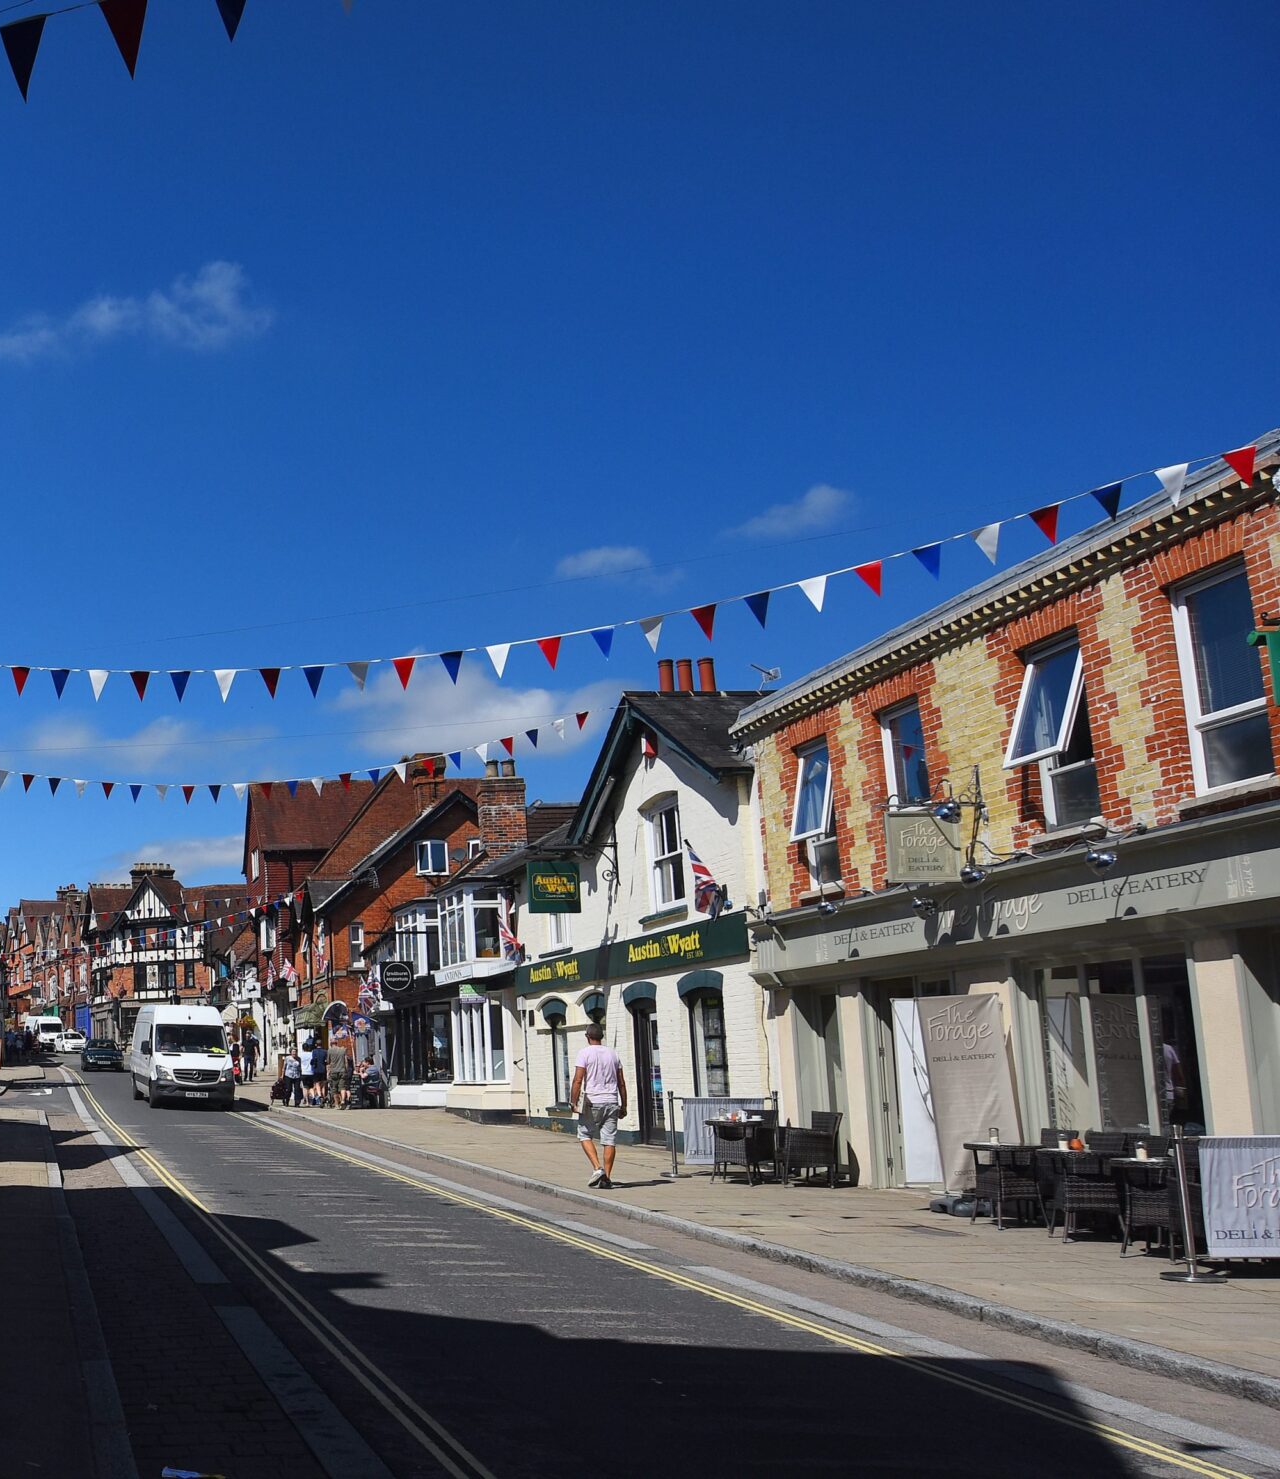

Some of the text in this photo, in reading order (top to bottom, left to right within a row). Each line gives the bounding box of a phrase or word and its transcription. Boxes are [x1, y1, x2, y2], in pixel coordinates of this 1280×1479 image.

[900, 826, 948, 853] Forage
[907, 819, 937, 836] The
[535, 874, 568, 886] Austin
[1111, 883, 1123, 898] &
[1128, 868, 1207, 895] EATERY
[860, 930, 868, 941] &
[869, 921, 916, 940] EATERY
[628, 939, 661, 963] Austin
[666, 930, 701, 957] Wyatt
[529, 966, 553, 983] Austin
[555, 958, 578, 979] Wyatt
[938, 1000, 977, 1025] The
[927, 1013, 994, 1051] Forage
[961, 1053, 997, 1061] EATERY
[1261, 1229, 1273, 1240] &
